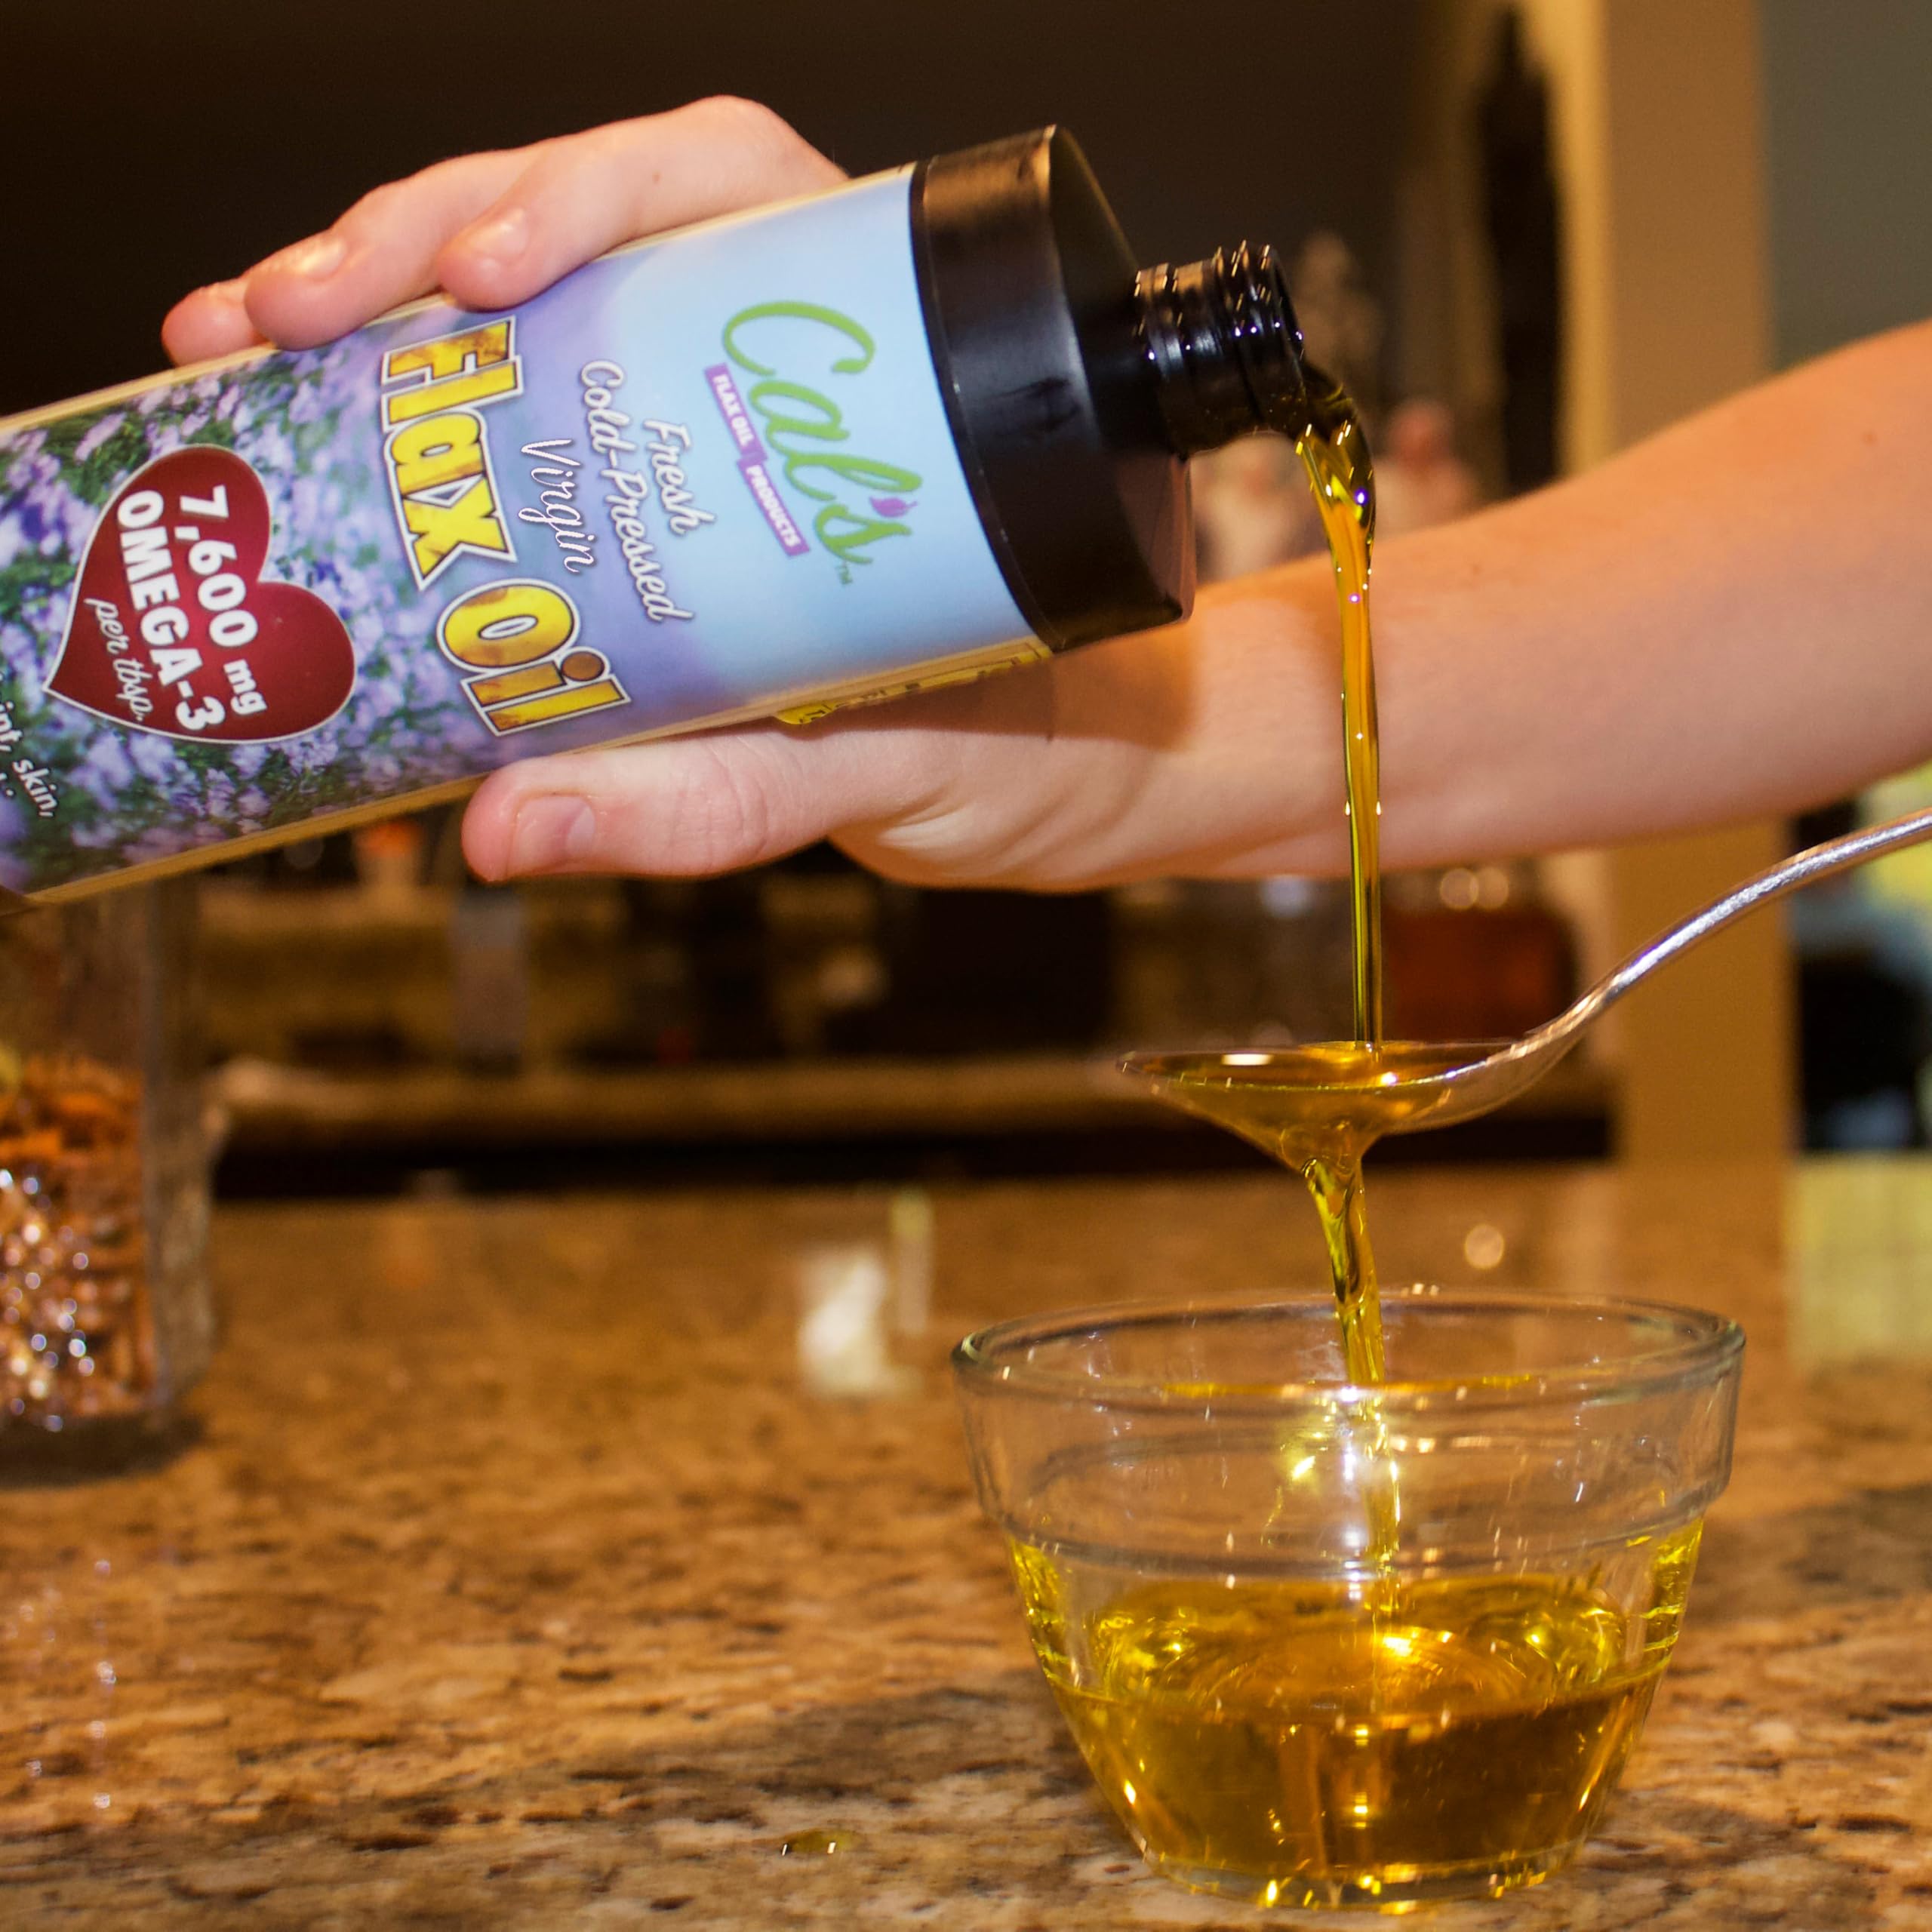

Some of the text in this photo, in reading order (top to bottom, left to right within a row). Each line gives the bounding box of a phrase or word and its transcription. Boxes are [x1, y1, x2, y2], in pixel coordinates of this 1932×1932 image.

[380, 315, 632, 737] Flax Oil
[518, 438, 596, 574] Virgin
[580, 360, 694, 623] Cold-Pressed
[642, 419, 717, 536] Fresh
[712, 373, 802, 549] FLAX OIL PRODUCTS
[83, 598, 153, 722] per tbsp.
[117, 490, 226, 731] OMEGA-3
[174, 485, 268, 715] 7,600 mg
[12, 758, 58, 818] skin,
